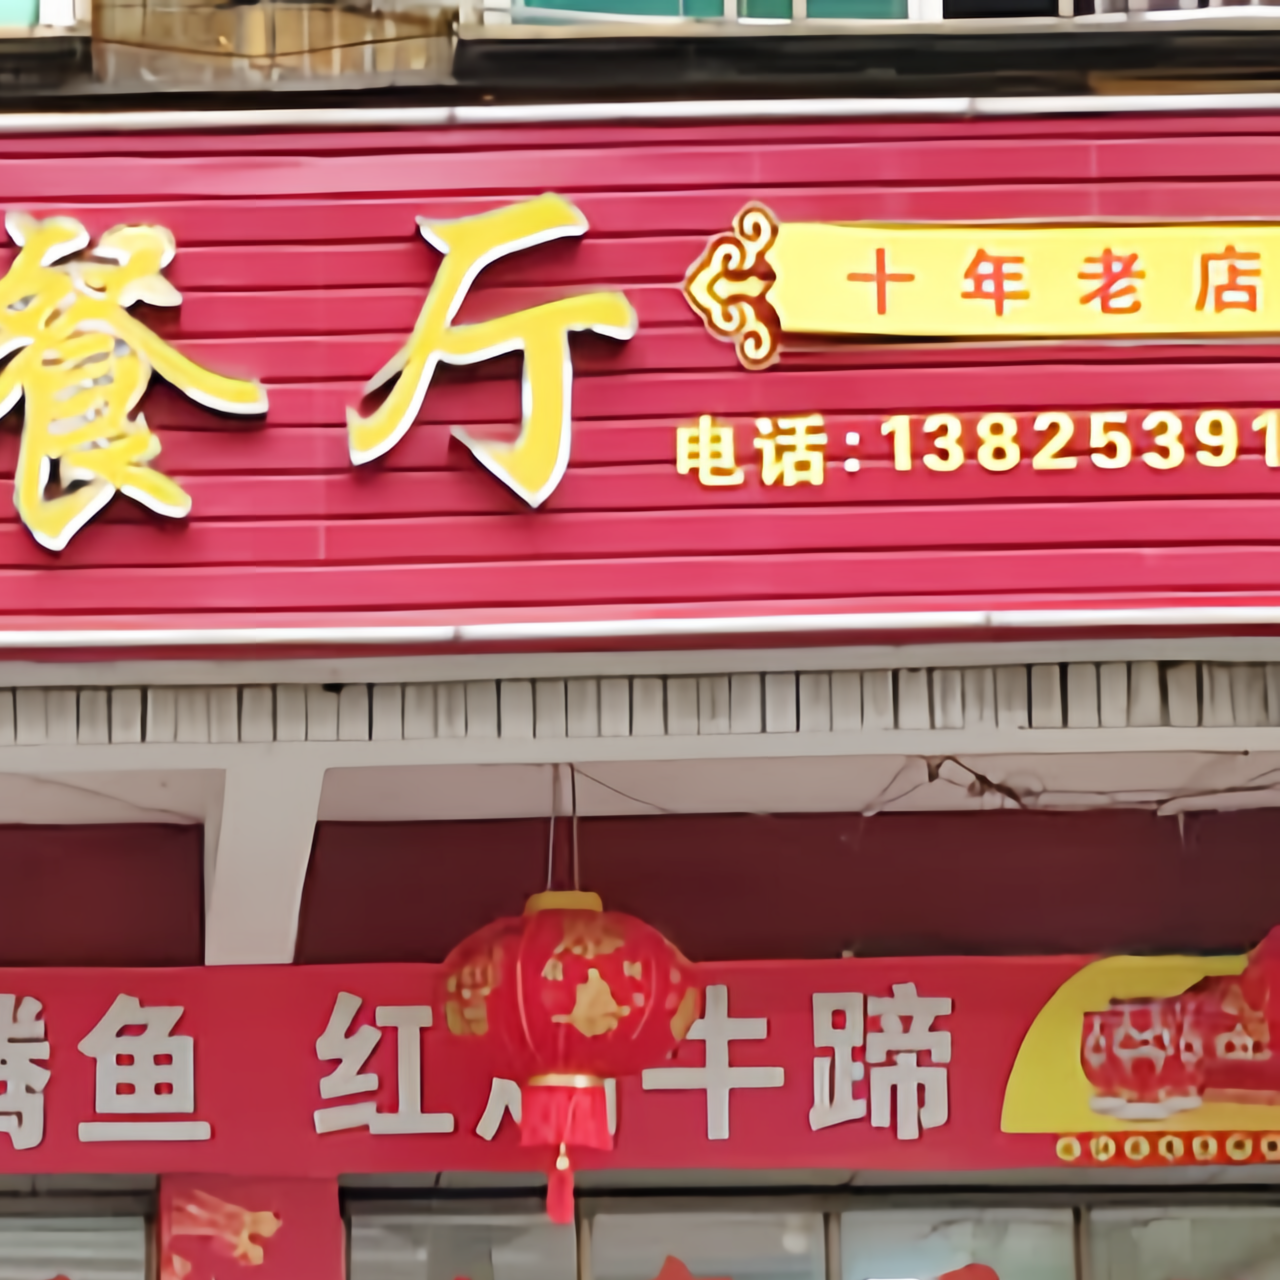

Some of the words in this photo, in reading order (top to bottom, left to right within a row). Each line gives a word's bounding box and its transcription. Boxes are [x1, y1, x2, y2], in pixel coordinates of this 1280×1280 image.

[846, 245, 1263, 317] 十年老店
[312, 982, 954, 1142] 红牛蹄
